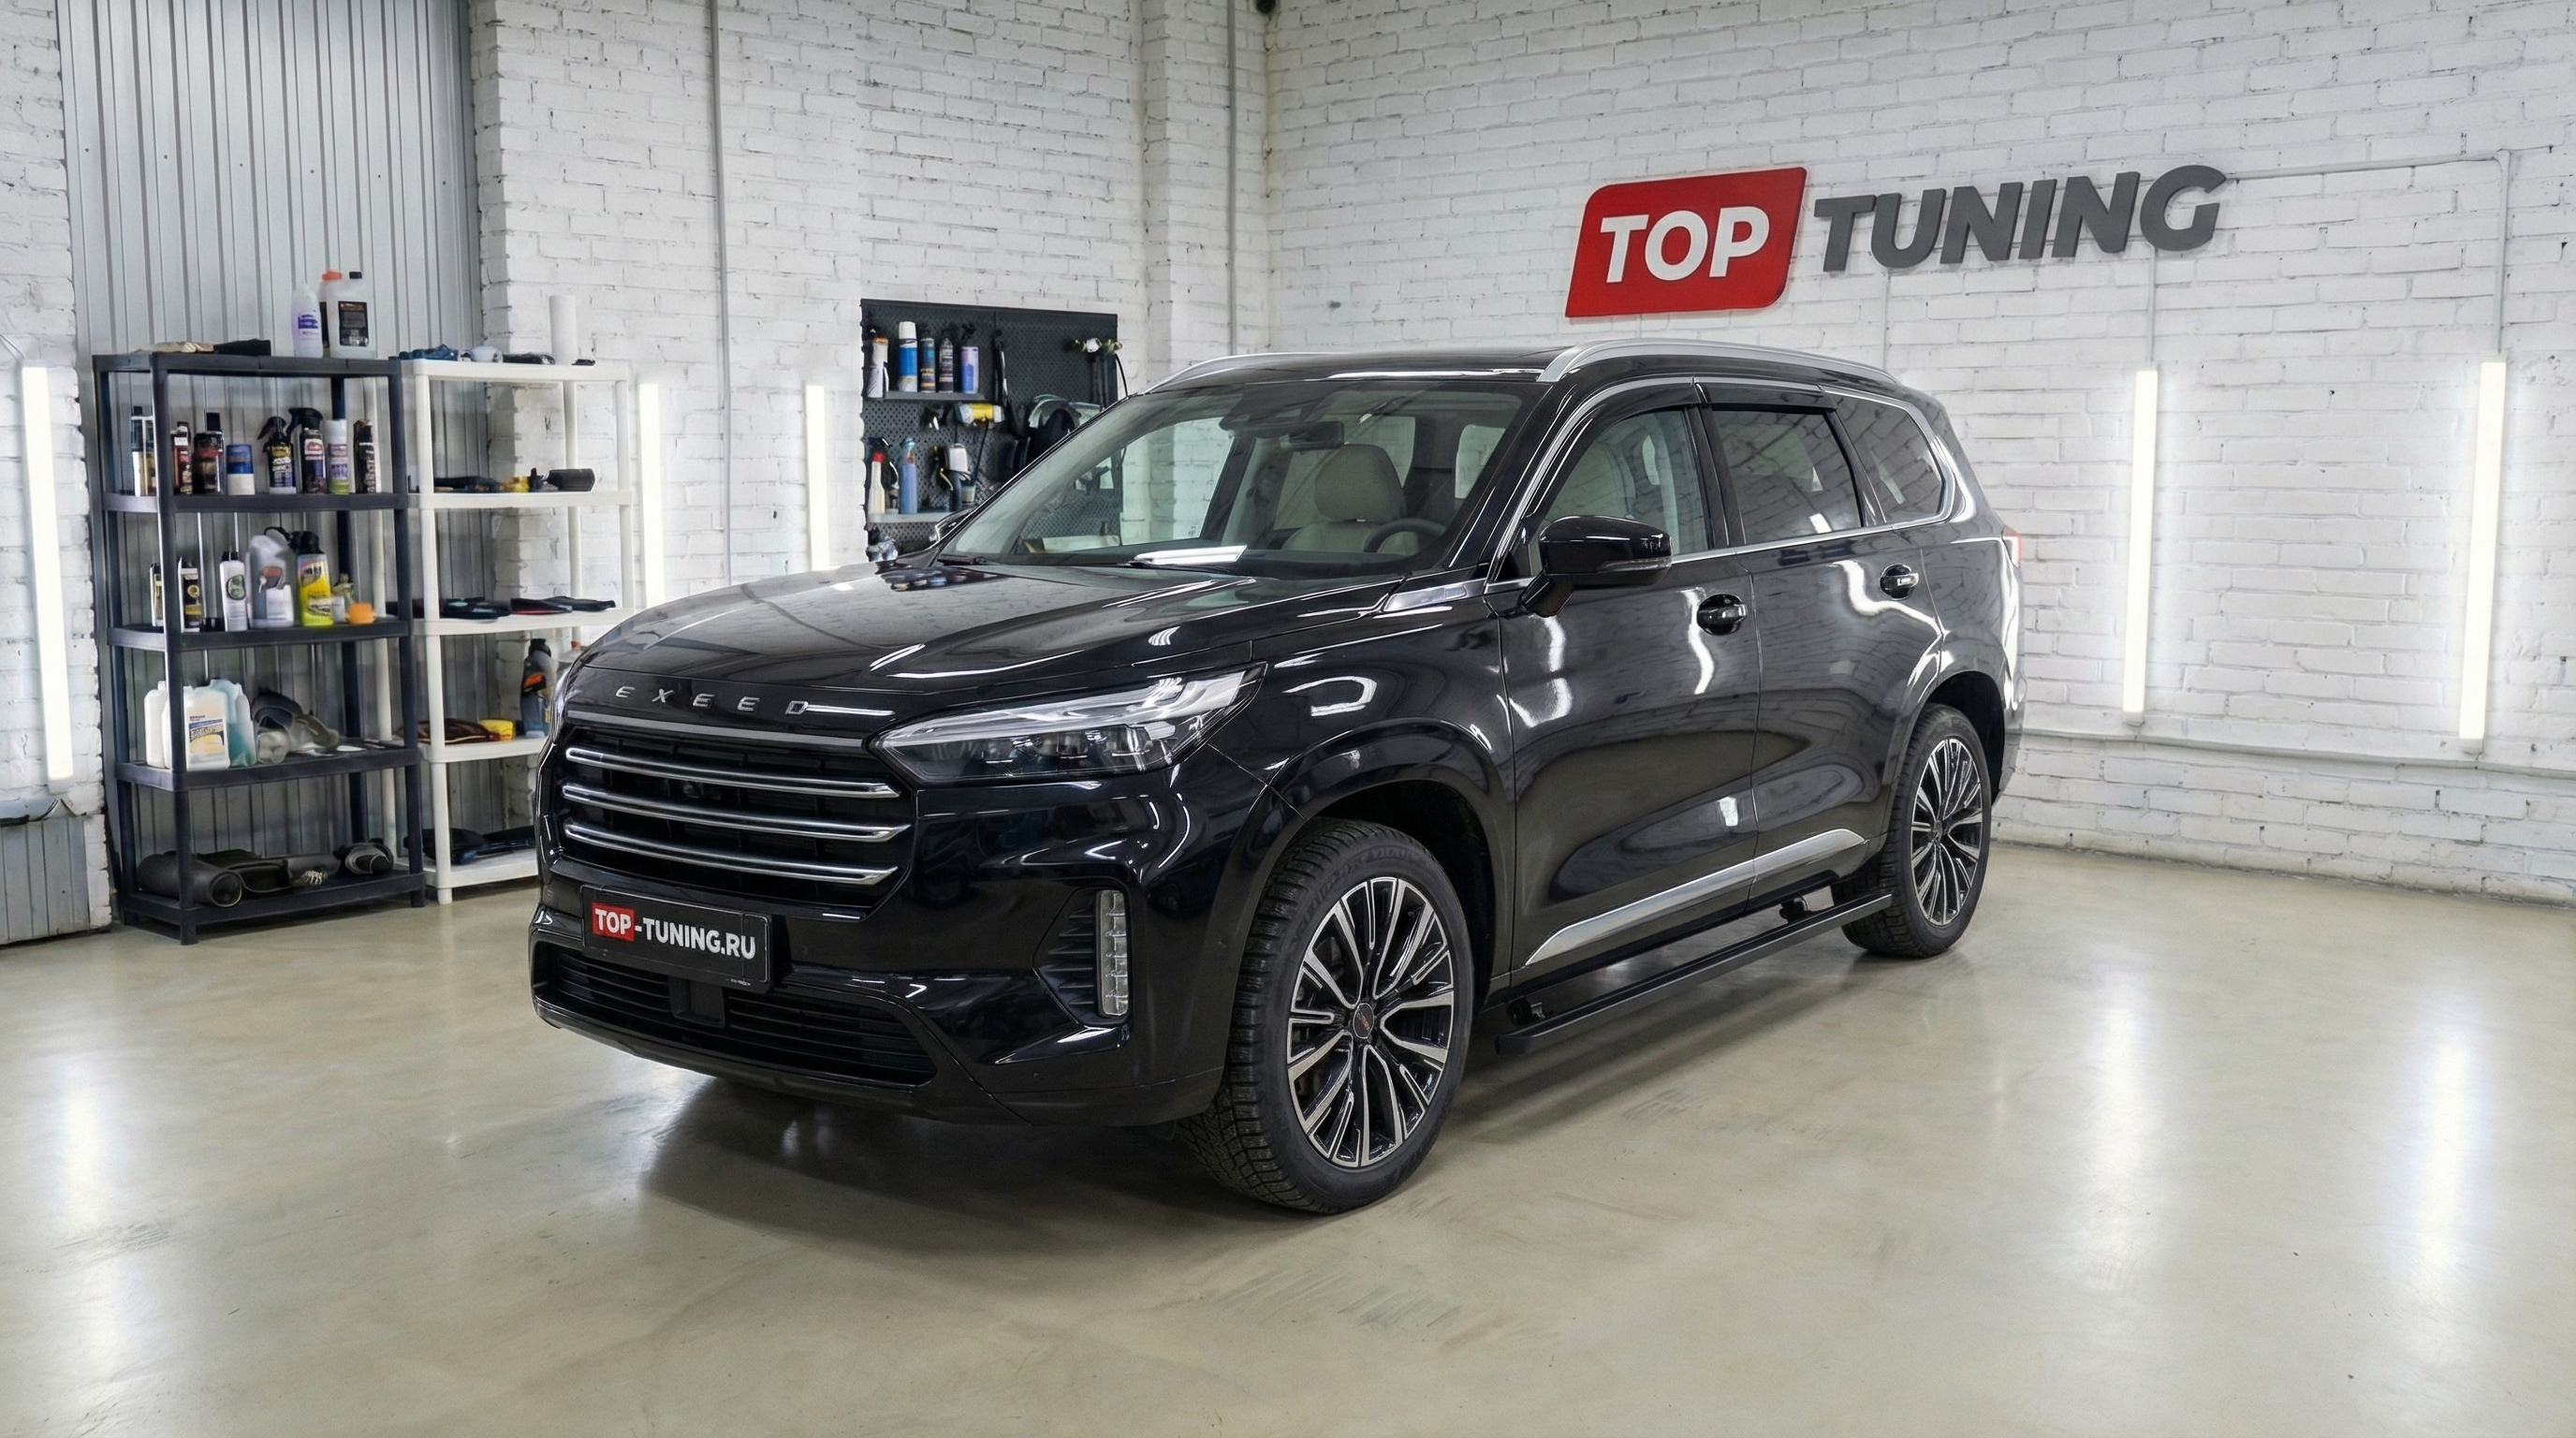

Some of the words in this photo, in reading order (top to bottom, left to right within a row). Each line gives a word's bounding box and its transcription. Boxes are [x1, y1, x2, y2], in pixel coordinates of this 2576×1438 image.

[1600, 205, 1770, 283] TOP
[1814, 165, 2227, 272] TUNING
[615, 685, 809, 715] EXEED
[594, 907, 756, 960] TOP-TUNING.RU
